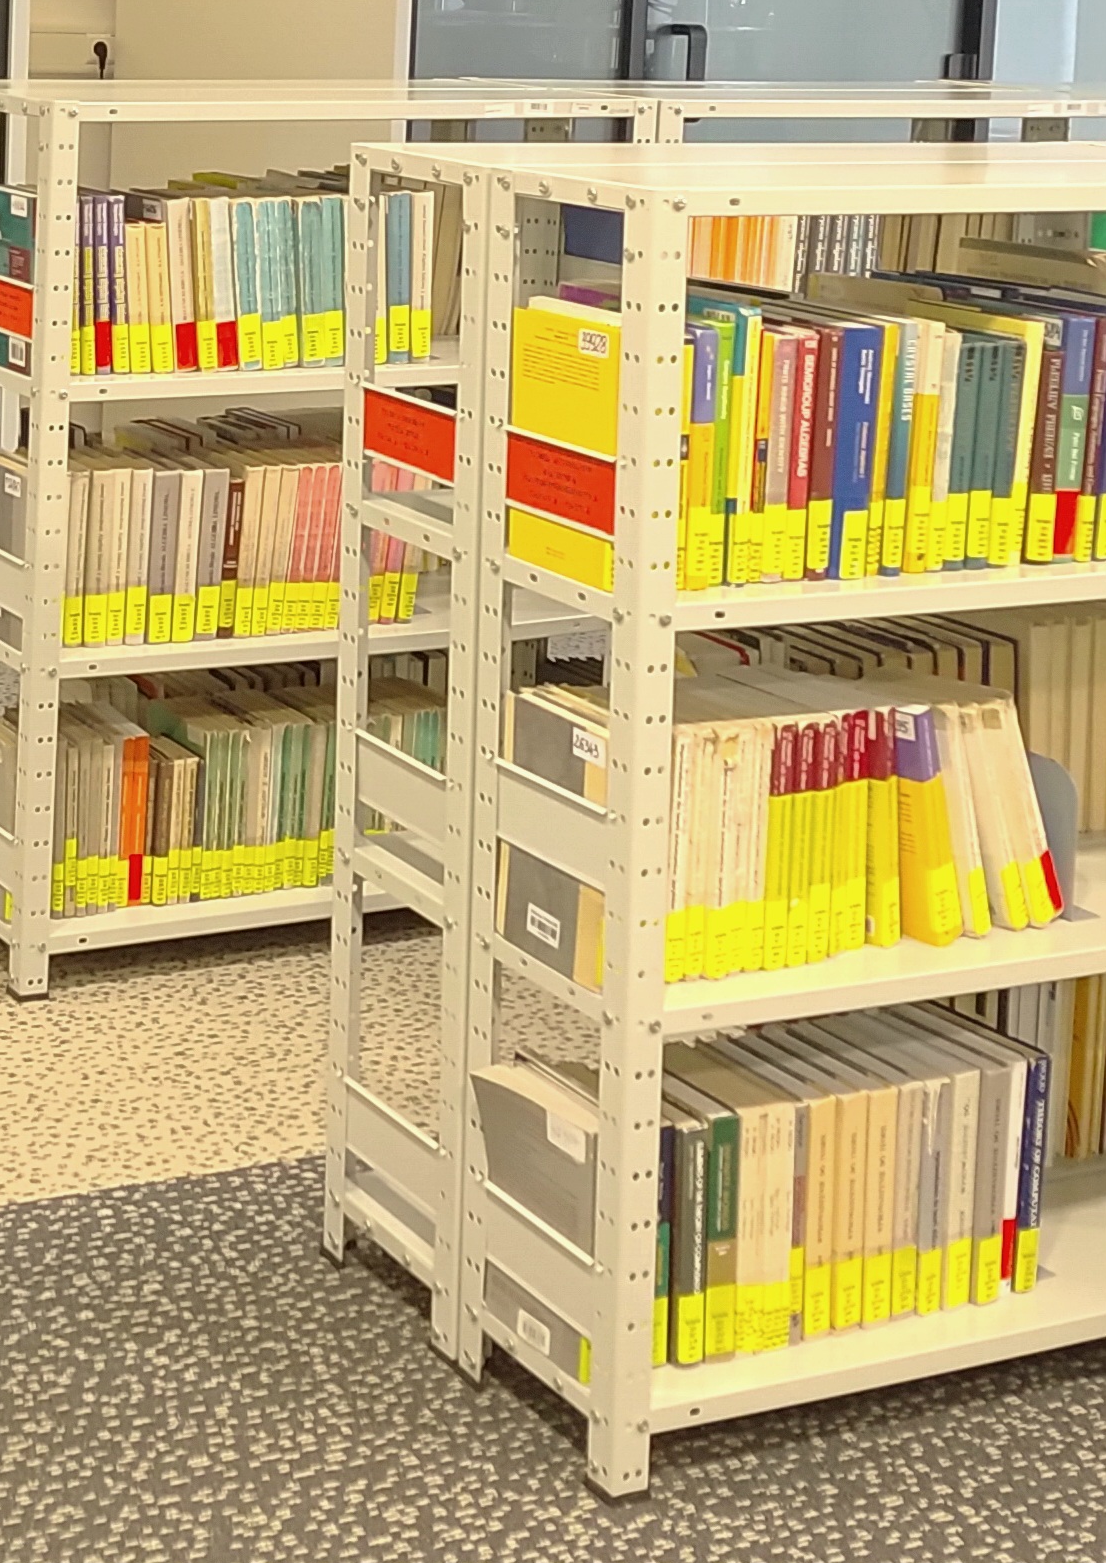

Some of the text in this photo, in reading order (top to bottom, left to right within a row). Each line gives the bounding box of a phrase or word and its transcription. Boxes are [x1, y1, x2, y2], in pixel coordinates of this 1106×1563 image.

[797, 355, 815, 477] SEMIGROUP ALGEBRAS
[1031, 1166, 1040, 1227] COMPUTAT
